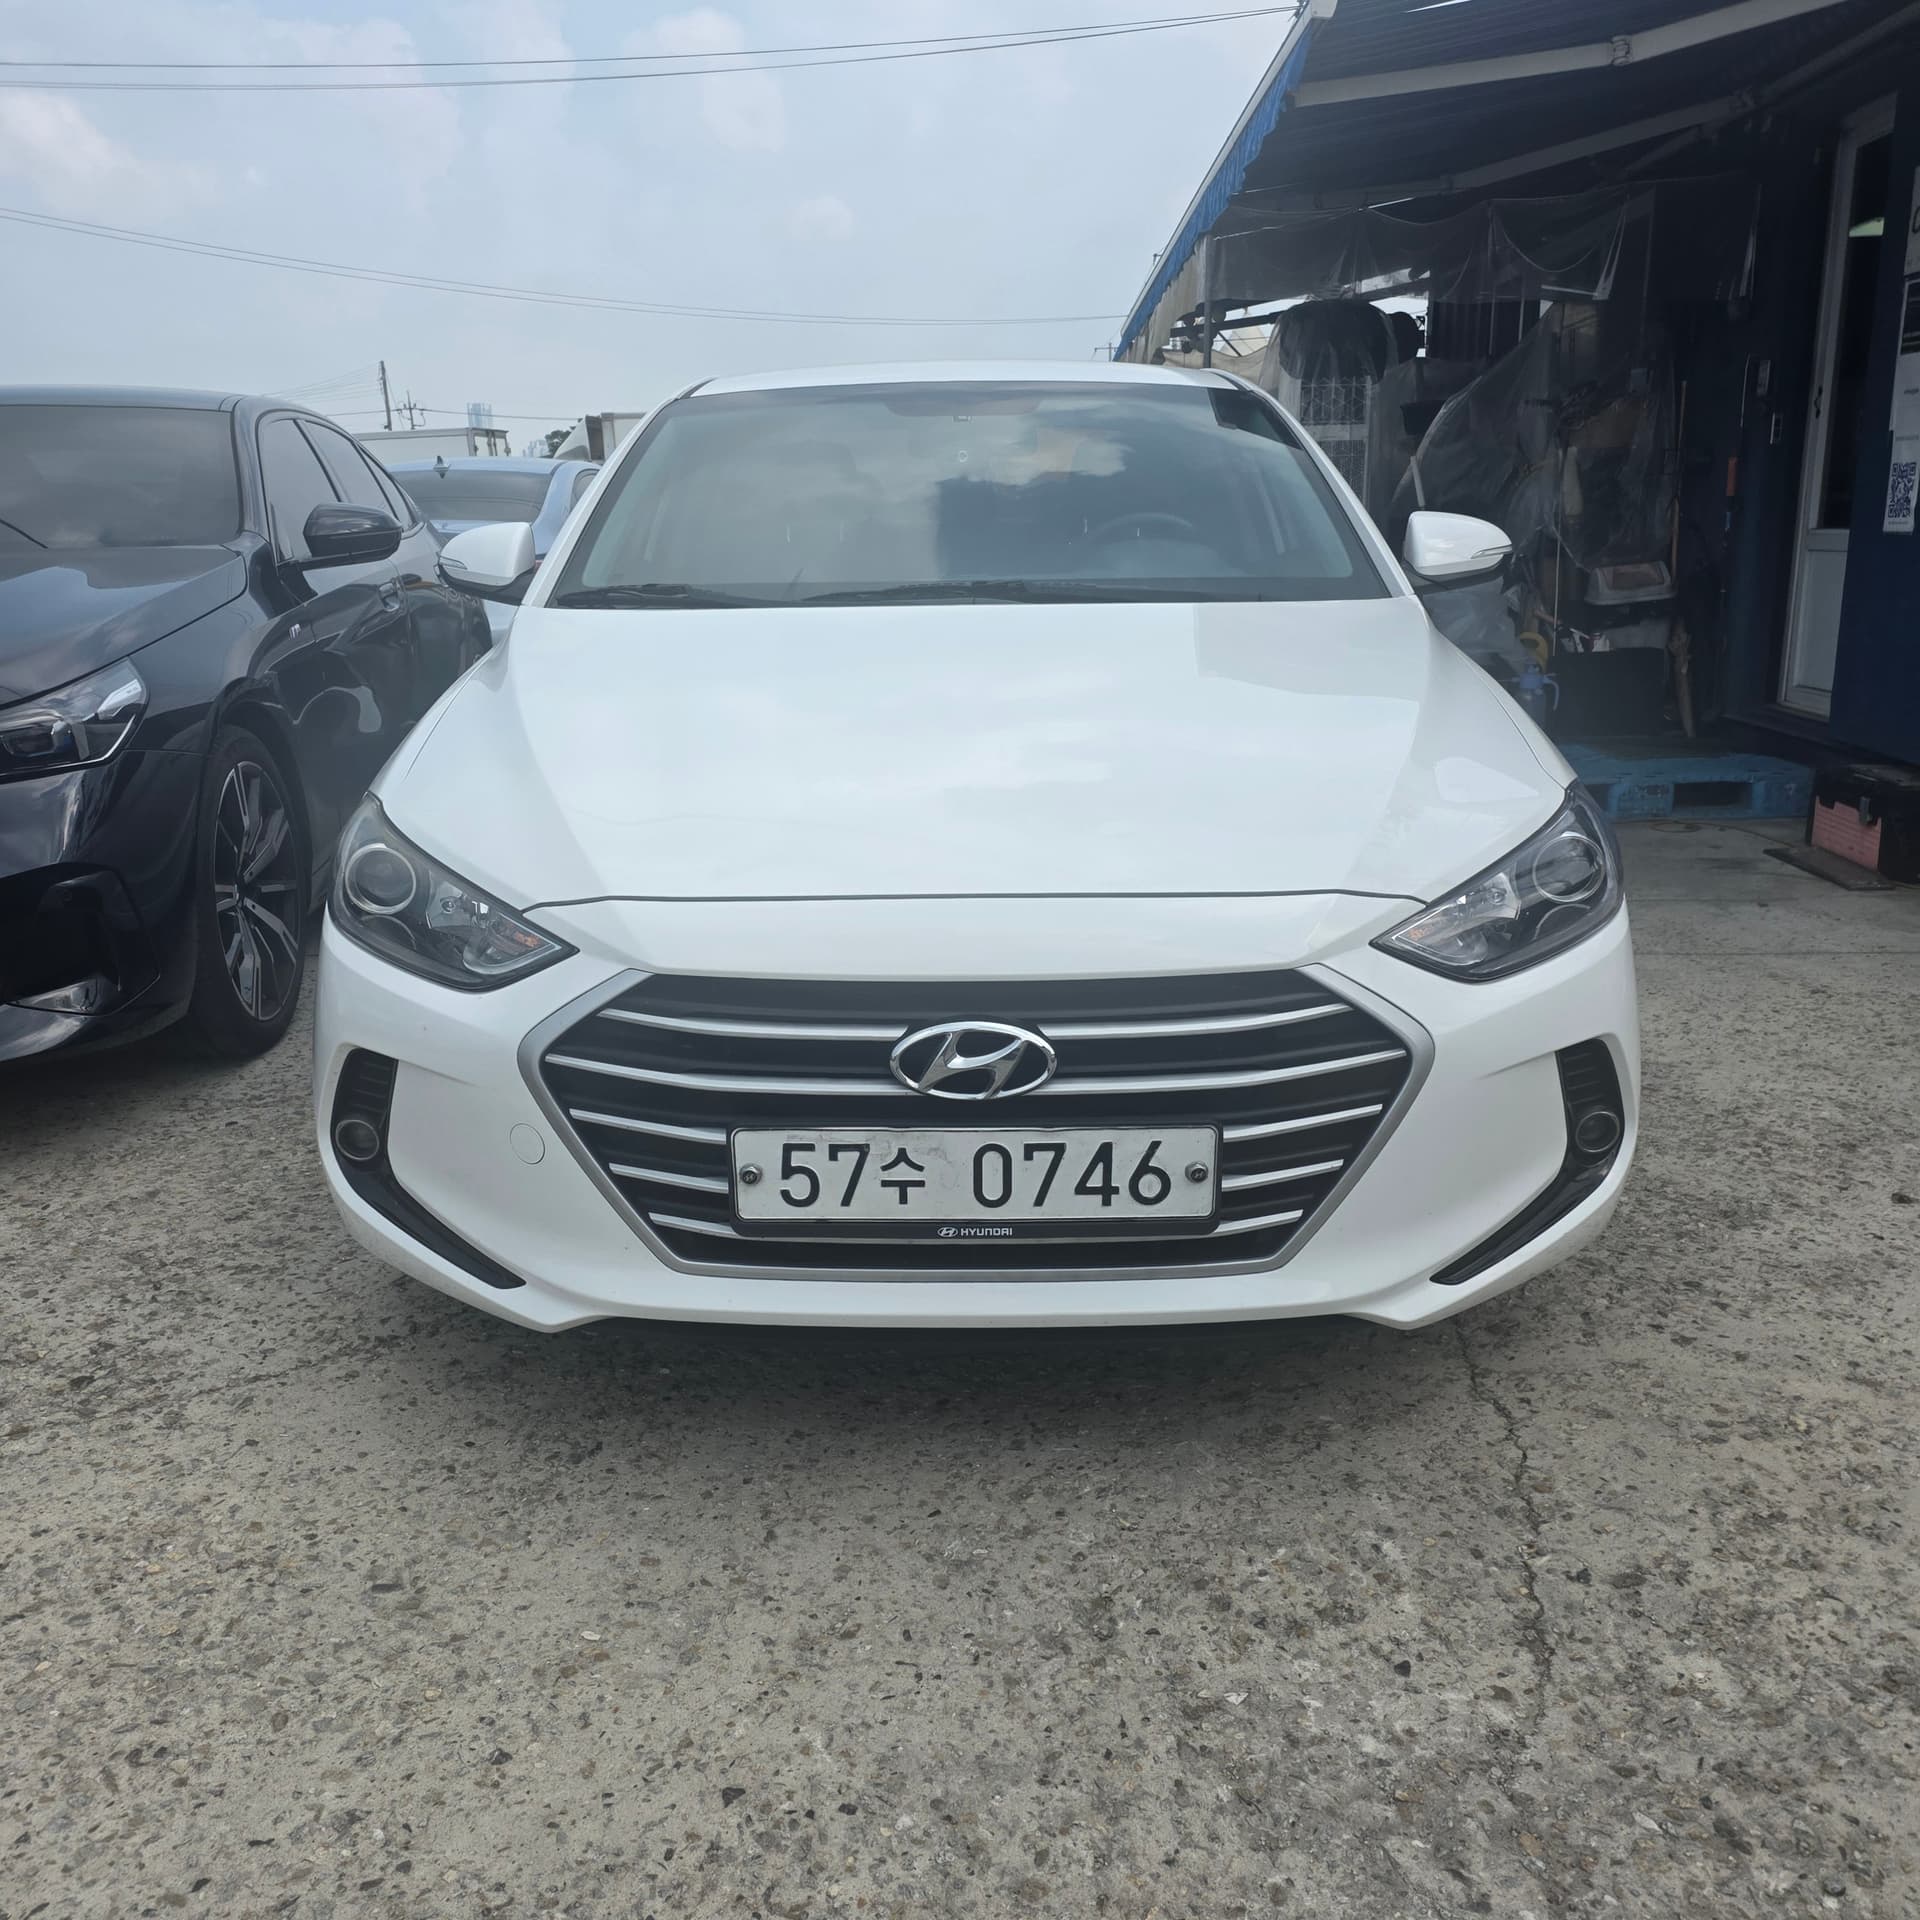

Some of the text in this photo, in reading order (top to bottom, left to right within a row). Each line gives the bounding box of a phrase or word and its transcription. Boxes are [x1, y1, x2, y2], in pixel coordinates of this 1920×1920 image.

[779, 1140, 1172, 1208] 57수 0746
[960, 1227, 1013, 1236] HYUNDAI
